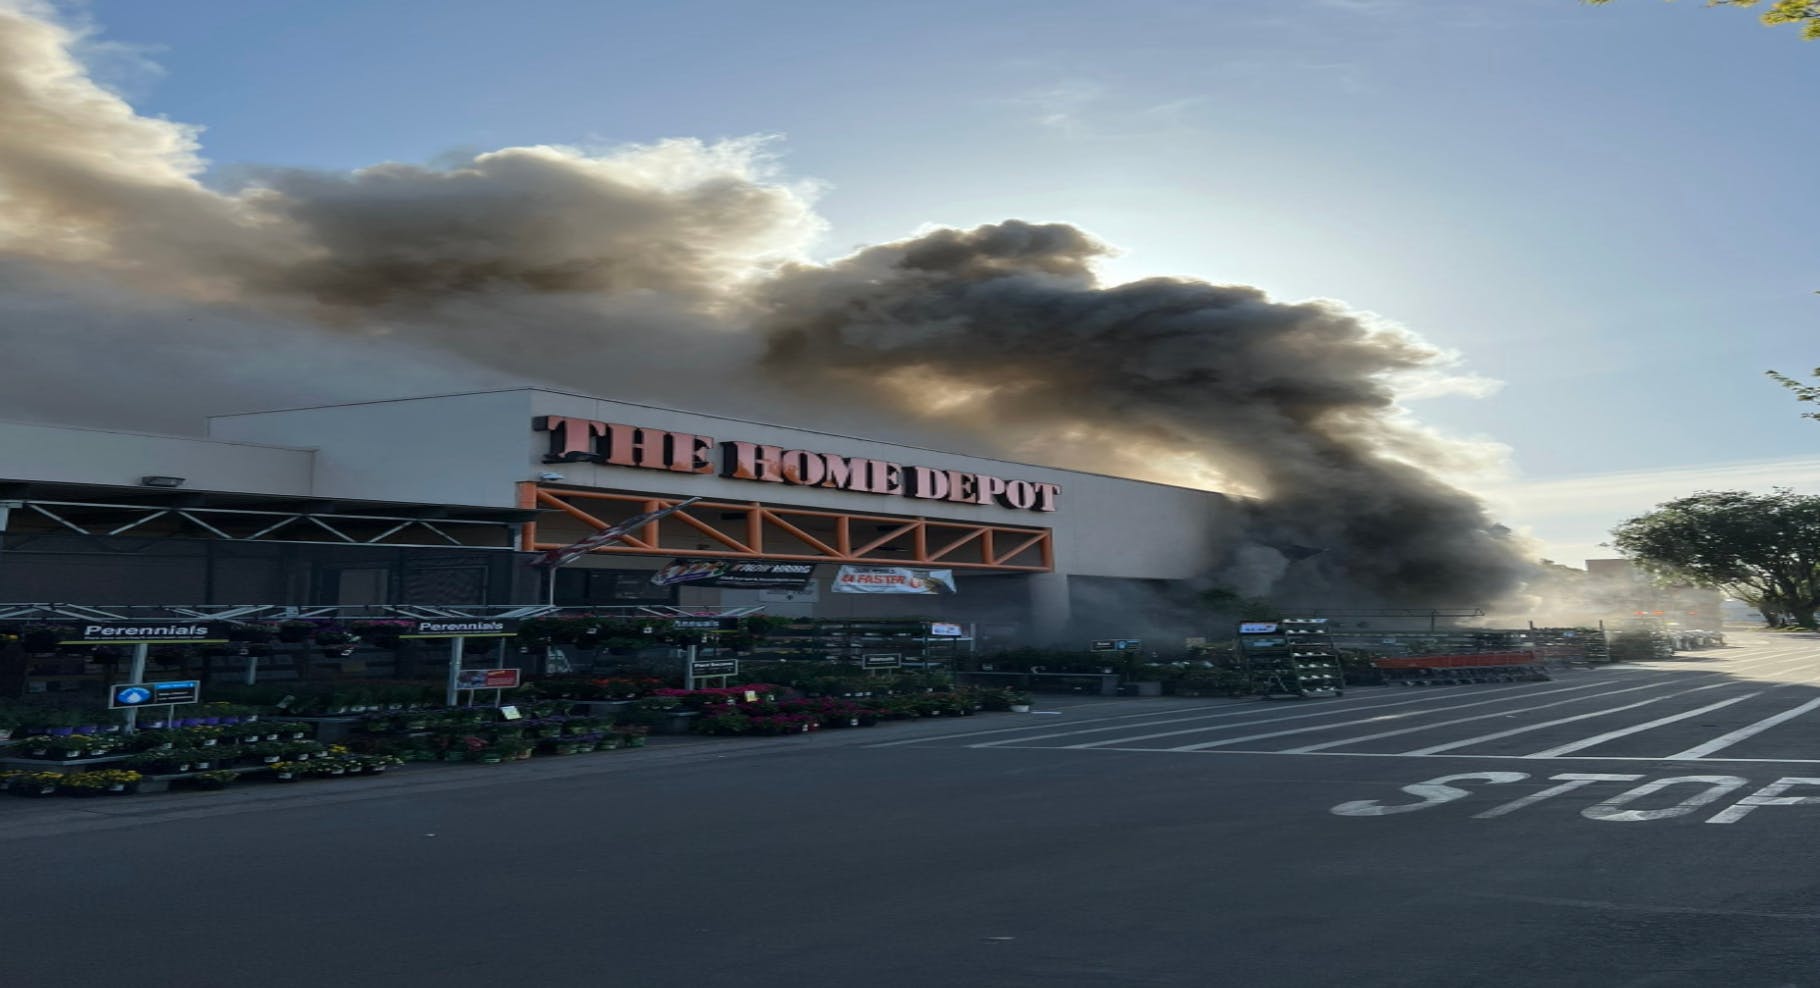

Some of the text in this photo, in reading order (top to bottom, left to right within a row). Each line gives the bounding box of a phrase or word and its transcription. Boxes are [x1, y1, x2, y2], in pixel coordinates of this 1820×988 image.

[538, 415, 1061, 513] THE HOME DEPOT
[857, 574, 905, 585] FASTER
[84, 625, 208, 636] Perennials
[419, 621, 504, 631] Perennials
